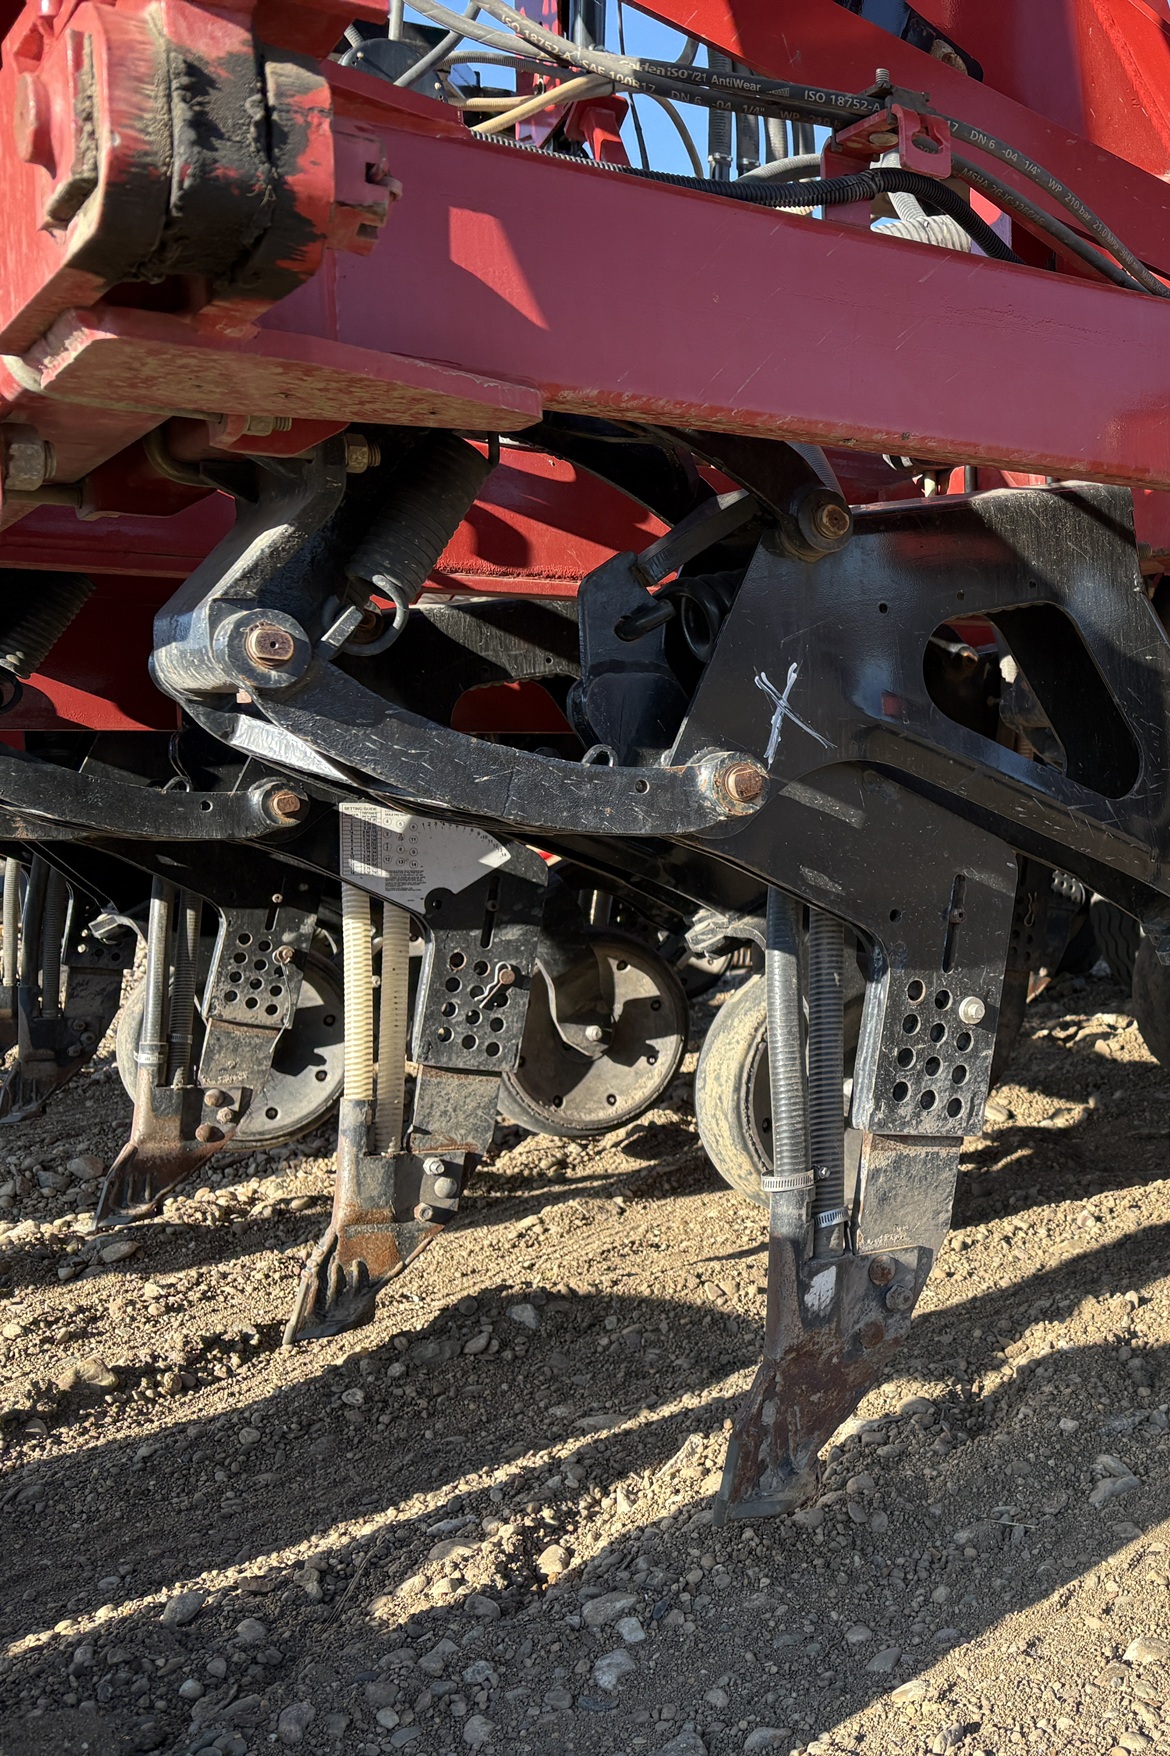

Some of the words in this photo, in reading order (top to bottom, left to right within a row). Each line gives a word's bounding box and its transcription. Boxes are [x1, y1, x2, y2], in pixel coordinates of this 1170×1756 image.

[501, 14, 521, 34] ISO
[671, 90, 690, 102] DN
[711, 75, 761, 92] AntiWear
[804, 90, 826, 103] ISO
[830, 95, 880, 112] 18752-A
[962, 167, 988, 189] MSHA
[969, 130, 987, 145] DN
[988, 139, 996, 149] 6
[1001, 149, 1018, 162] -04
[1048, 178, 1063, 192] WP
[1064, 192, 1080, 210] 210
[1079, 205, 1092, 221] bar
[1092, 219, 1108, 237] 21.0
